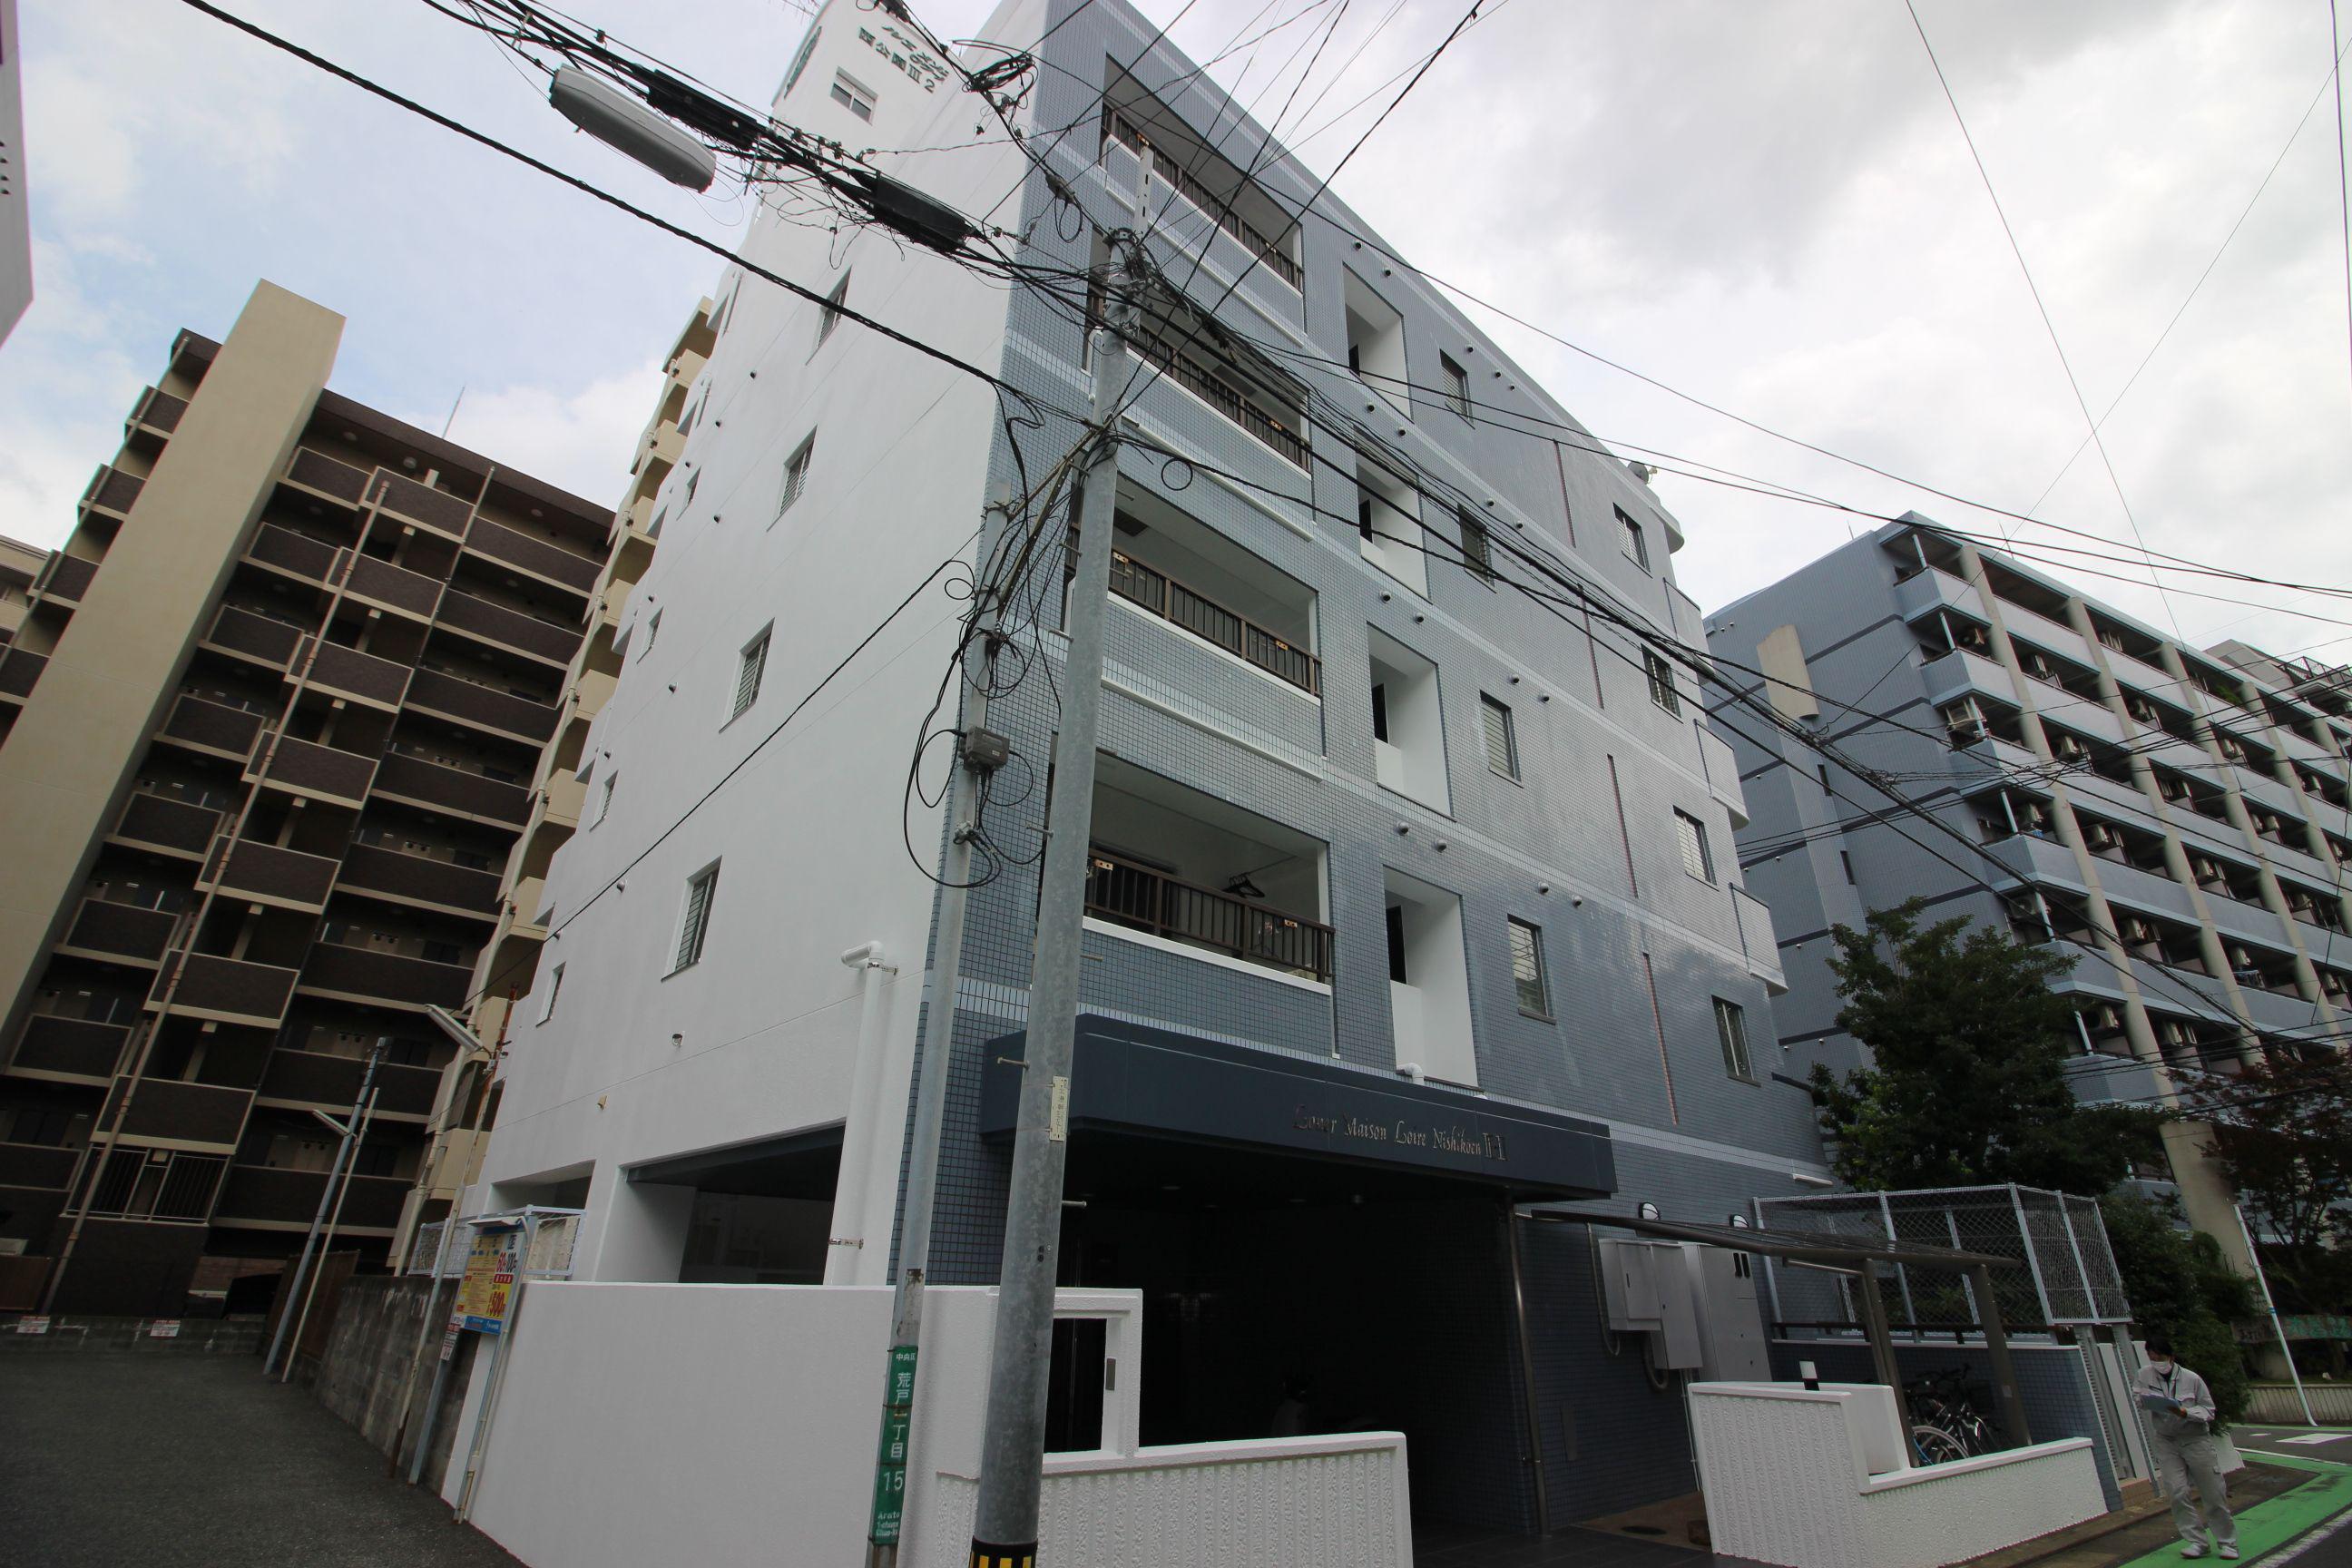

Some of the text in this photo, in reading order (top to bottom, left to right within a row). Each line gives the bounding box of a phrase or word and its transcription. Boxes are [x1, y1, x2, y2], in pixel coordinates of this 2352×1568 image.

[1344, 1111, 1387, 1140] Maison
[1396, 1120, 1426, 1147] Loire
[896, 1353, 915, 1362] 中央区
[883, 1470, 904, 1491] 15
